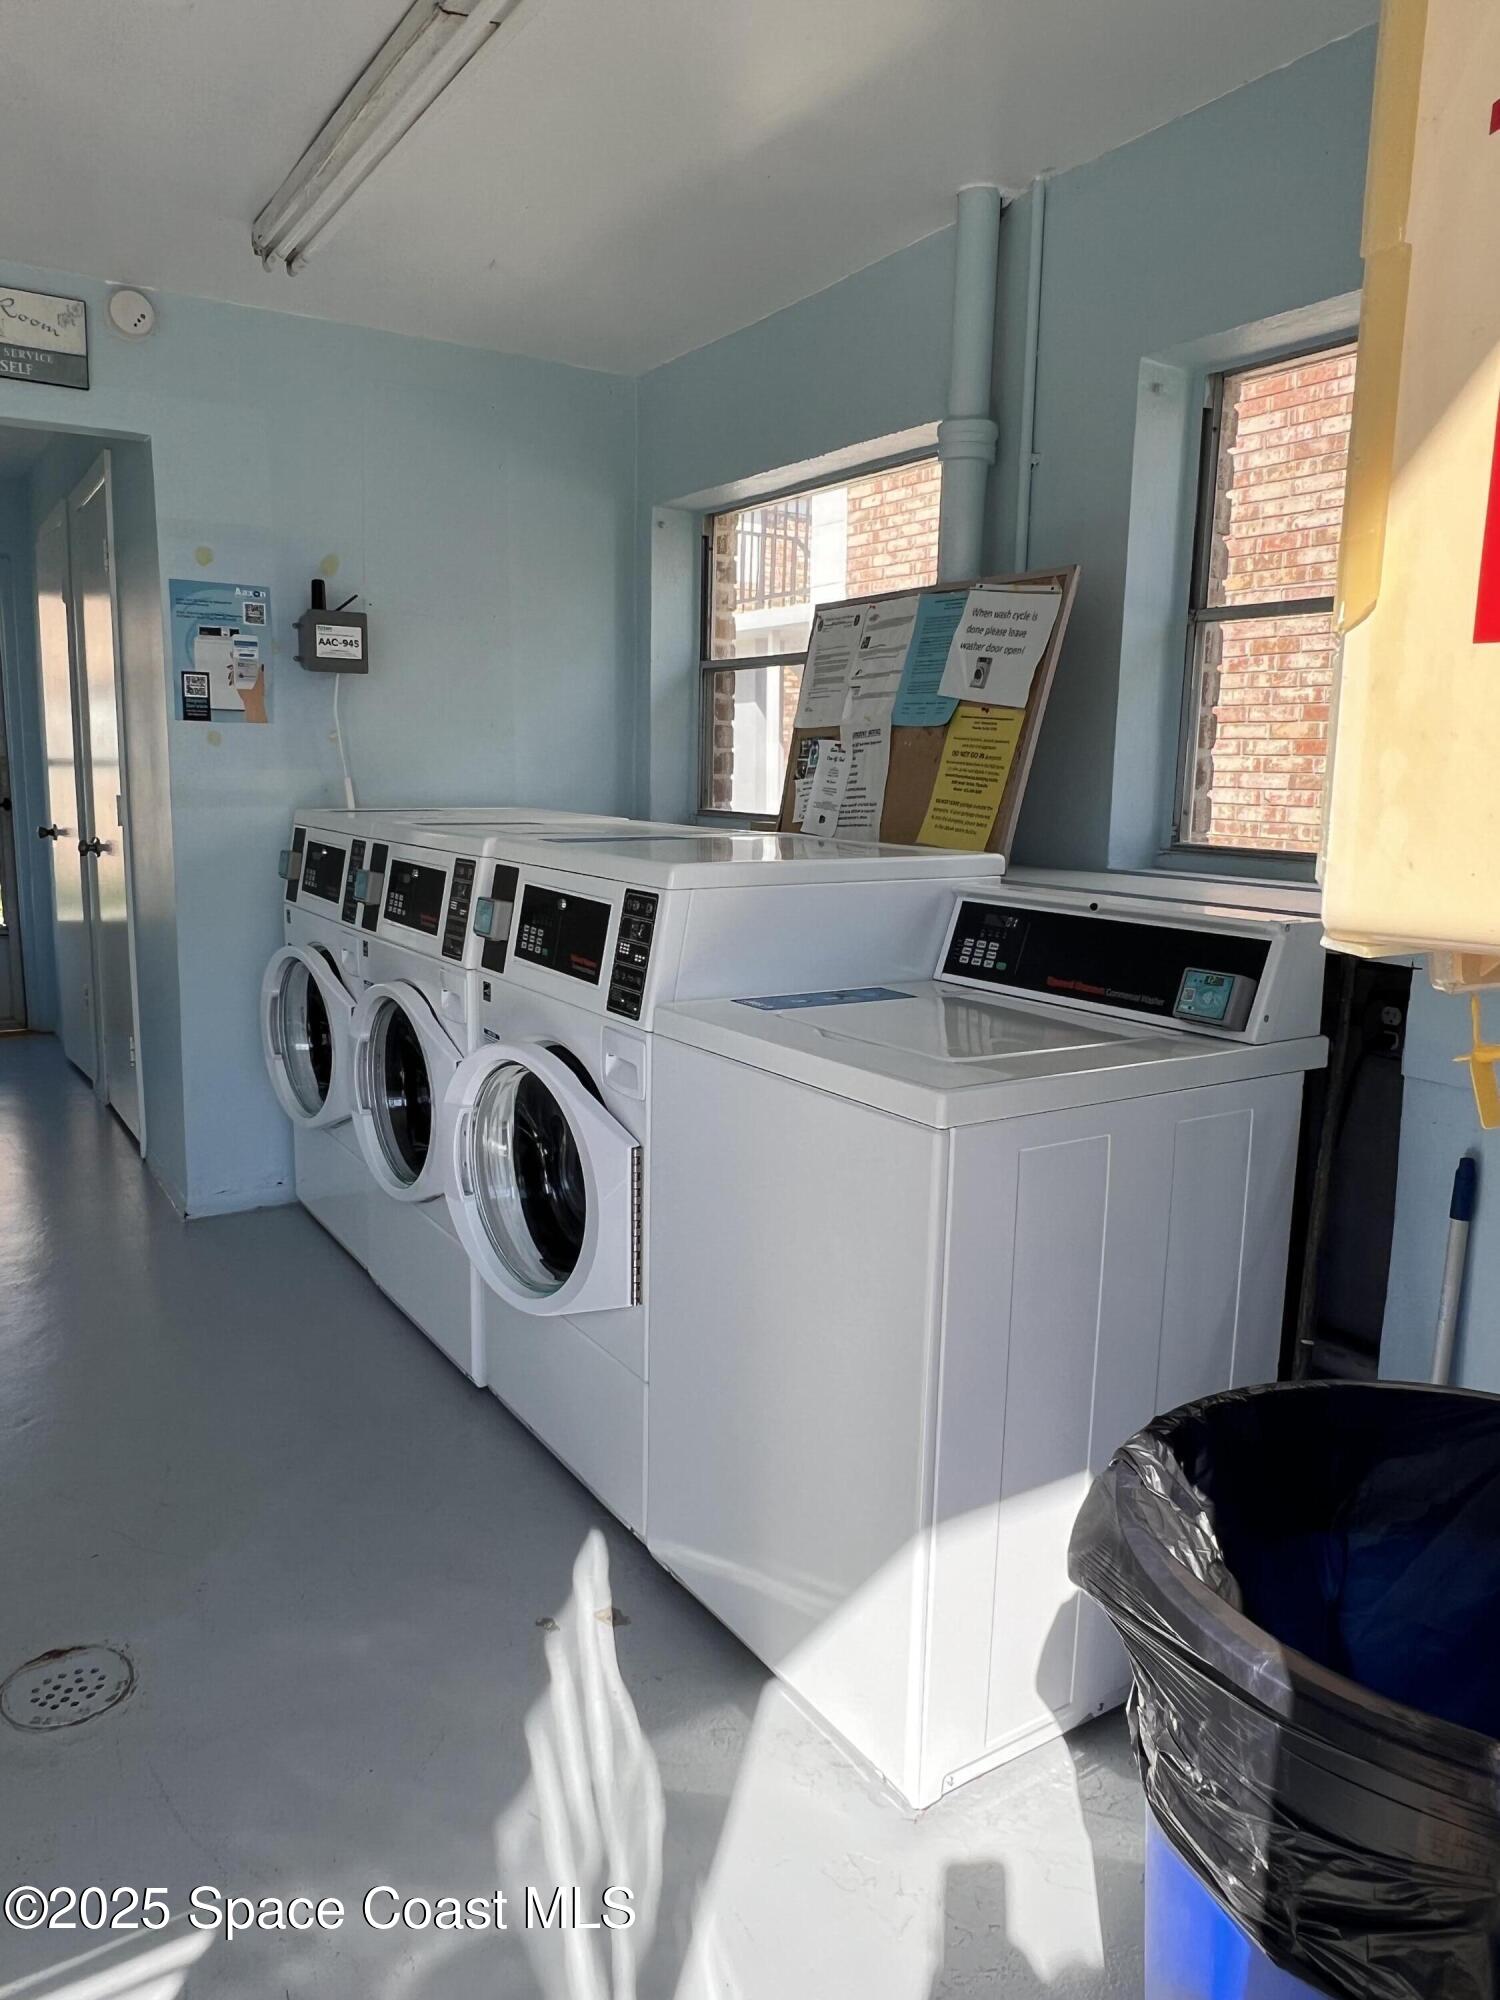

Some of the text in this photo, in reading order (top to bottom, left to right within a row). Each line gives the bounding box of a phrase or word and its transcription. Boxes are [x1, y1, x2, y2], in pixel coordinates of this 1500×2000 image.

[4, 347, 53, 363] SERVICE
[972, 607, 1039, 622] When wash cycle is
[966, 624, 1028, 639] done please leave
[318, 637, 360, 649] AAC-945
[960, 641, 985, 652] washer
[985, 642, 1003, 653] door
